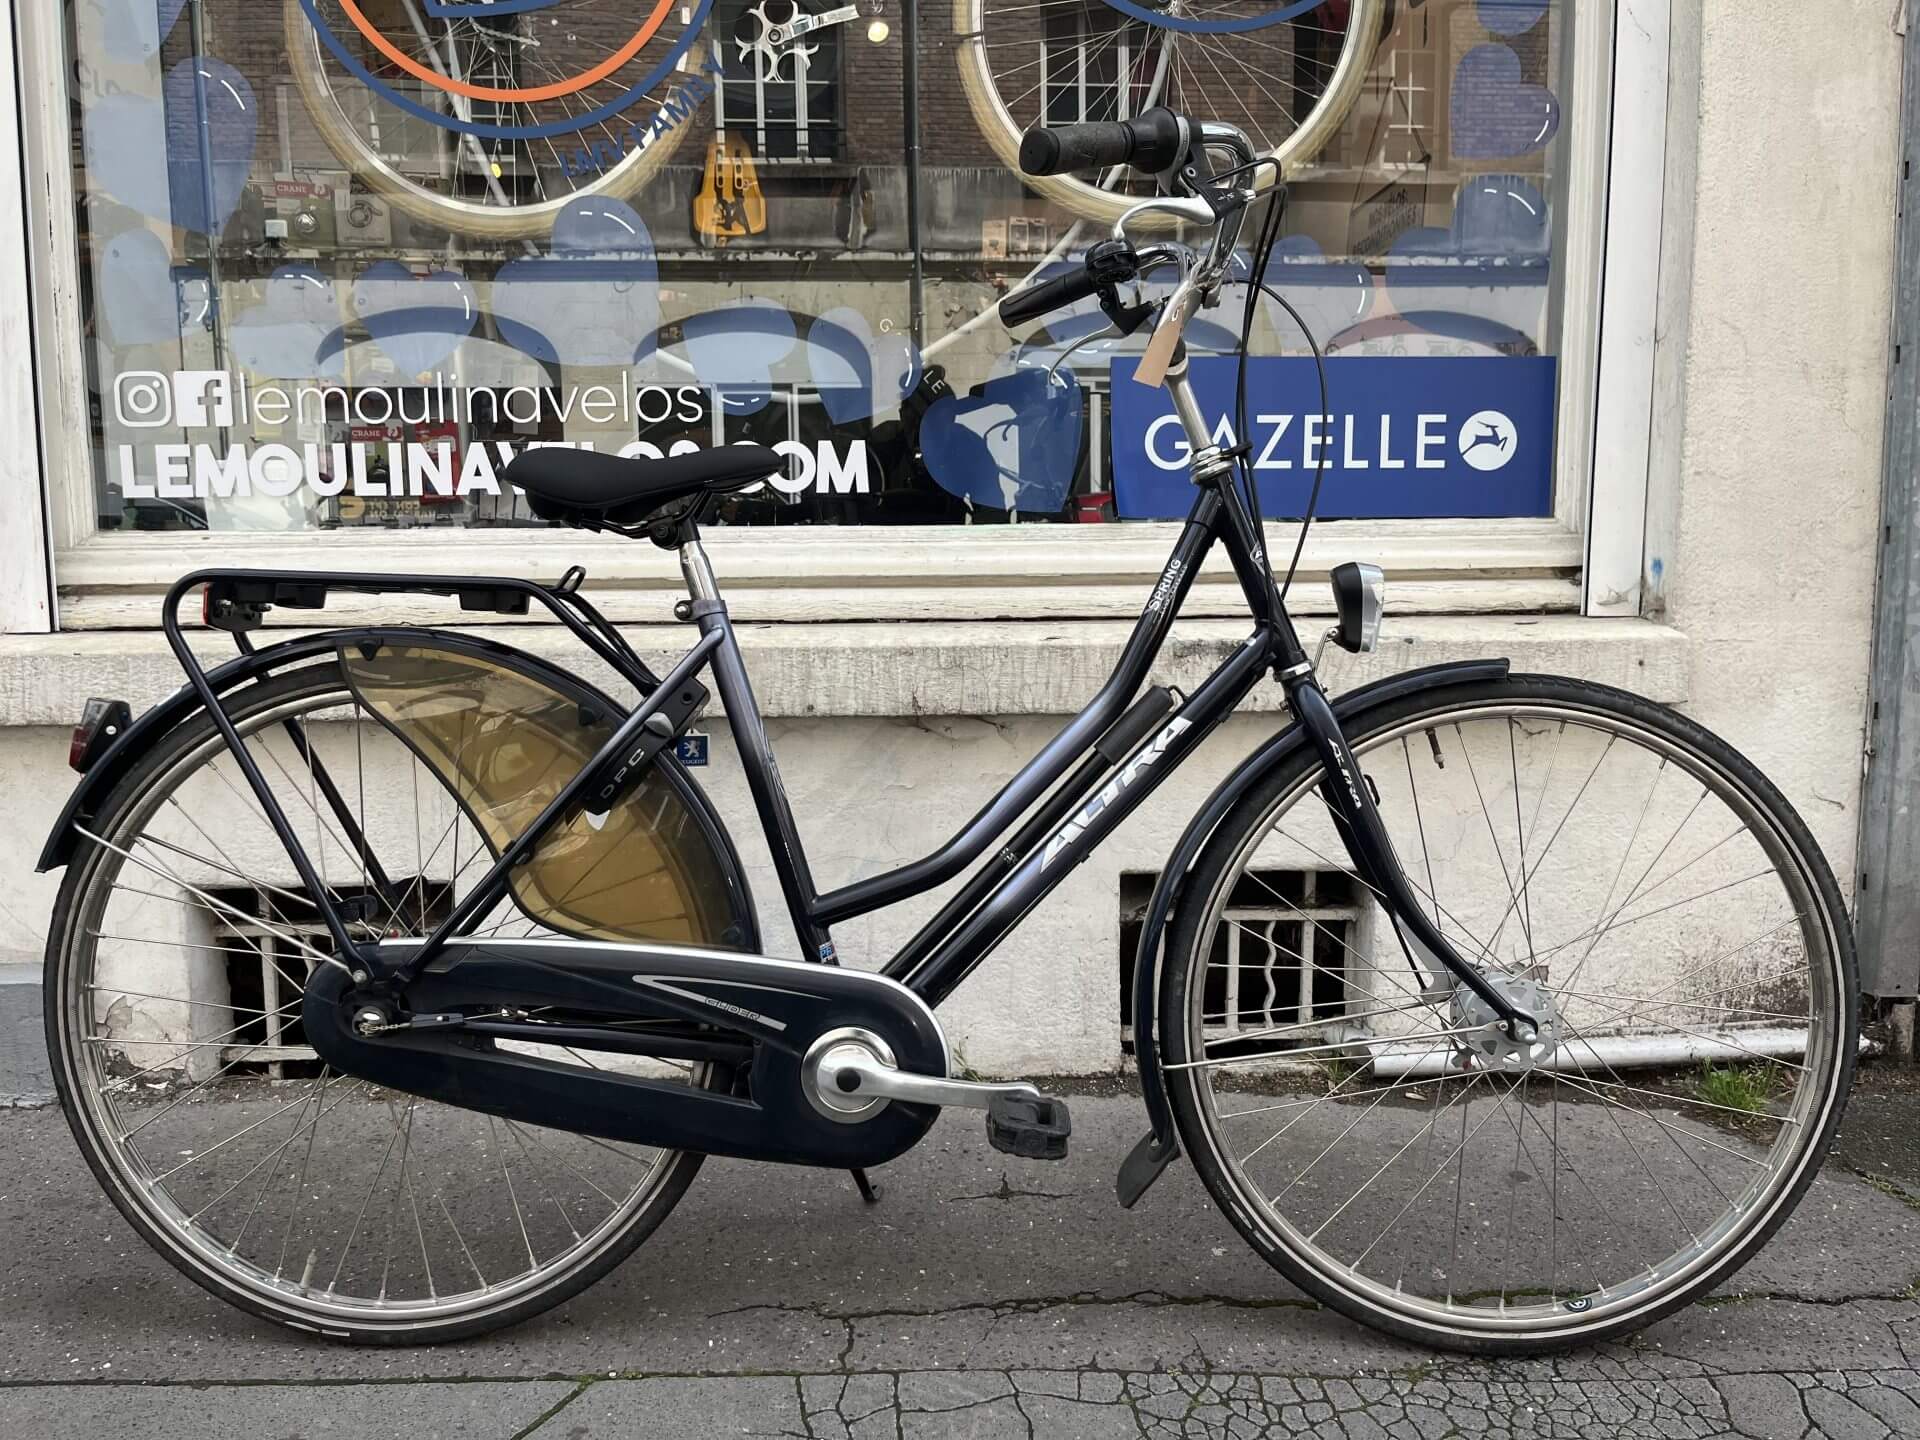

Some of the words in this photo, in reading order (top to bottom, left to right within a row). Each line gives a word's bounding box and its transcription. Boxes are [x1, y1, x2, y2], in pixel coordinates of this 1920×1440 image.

[559, 131, 625, 177] LMV
[627, 50, 727, 150] FAMILY
[239, 371, 703, 425] lemoulinavelos
[351, 429, 382, 438] CRANE
[1144, 412, 1448, 471] GAZELLE
[119, 440, 870, 498] LEMOULINAOM
[1148, 559, 1182, 612] SPRING
